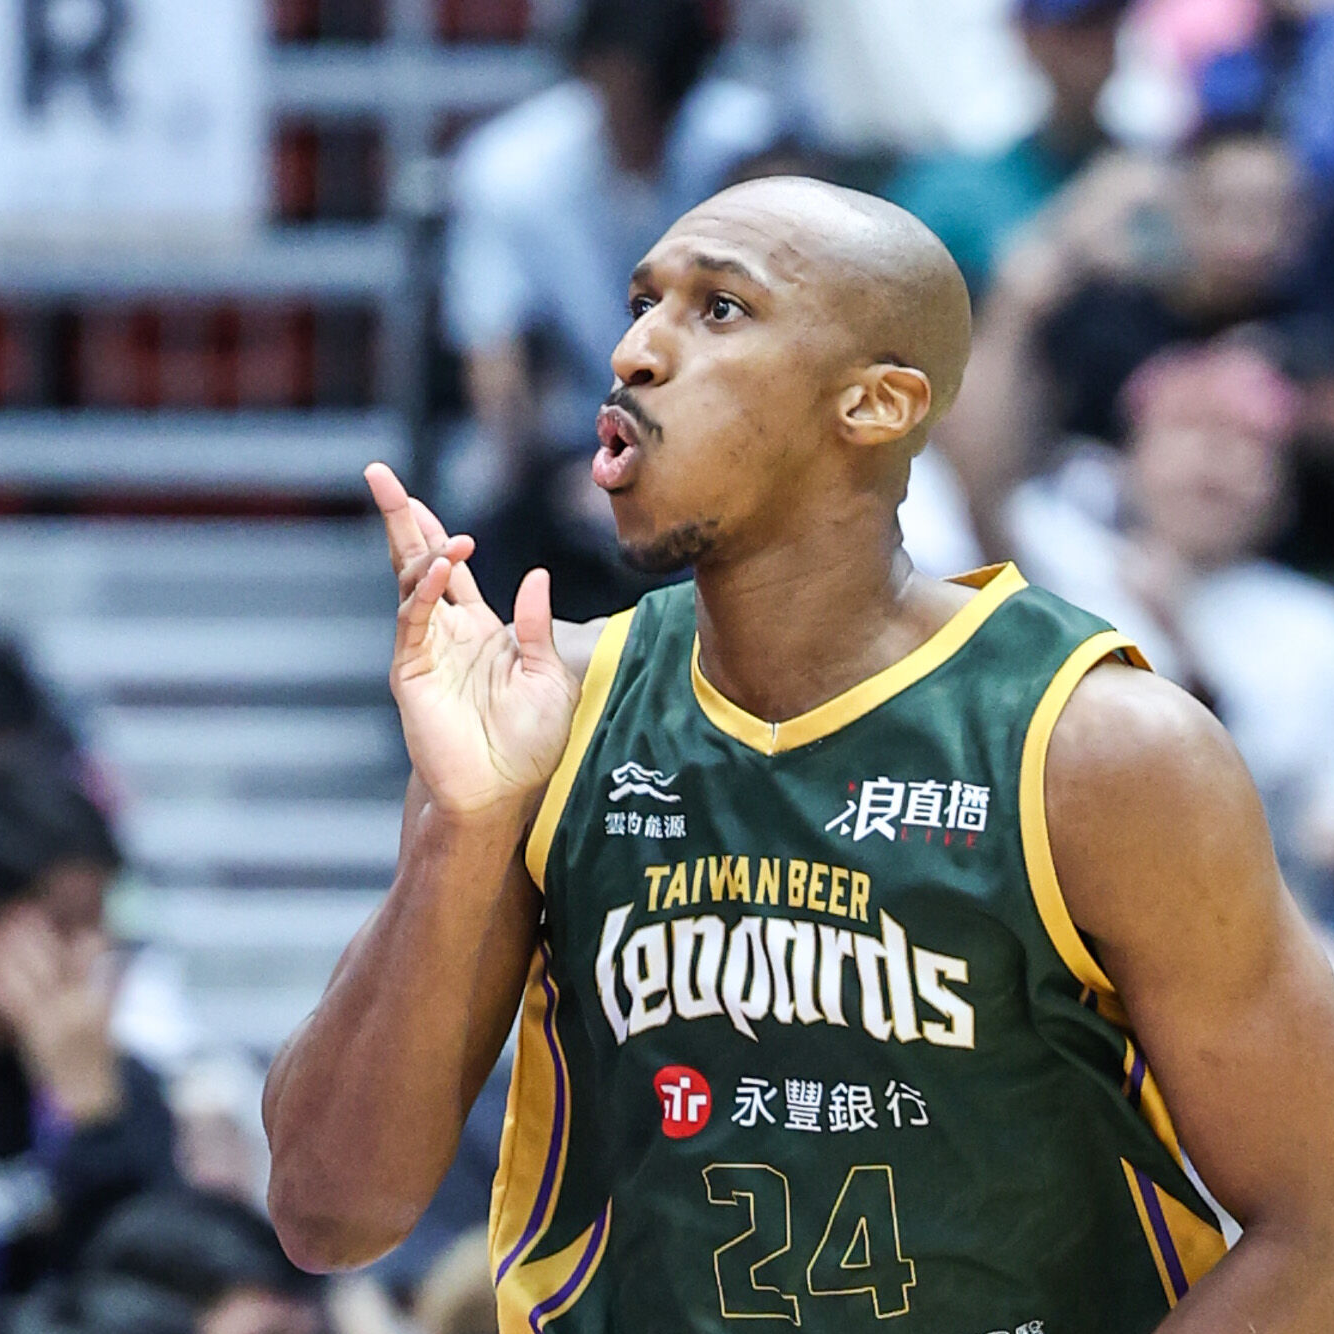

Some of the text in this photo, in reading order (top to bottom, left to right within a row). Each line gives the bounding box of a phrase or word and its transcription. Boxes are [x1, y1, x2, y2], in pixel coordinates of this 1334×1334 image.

[825, 776, 990, 842] 浪直播
[644, 855, 871, 923] TAIWAN BEER
[730, 1076, 931, 1133] 永豐銀行
[702, 1163, 917, 1326] 24
